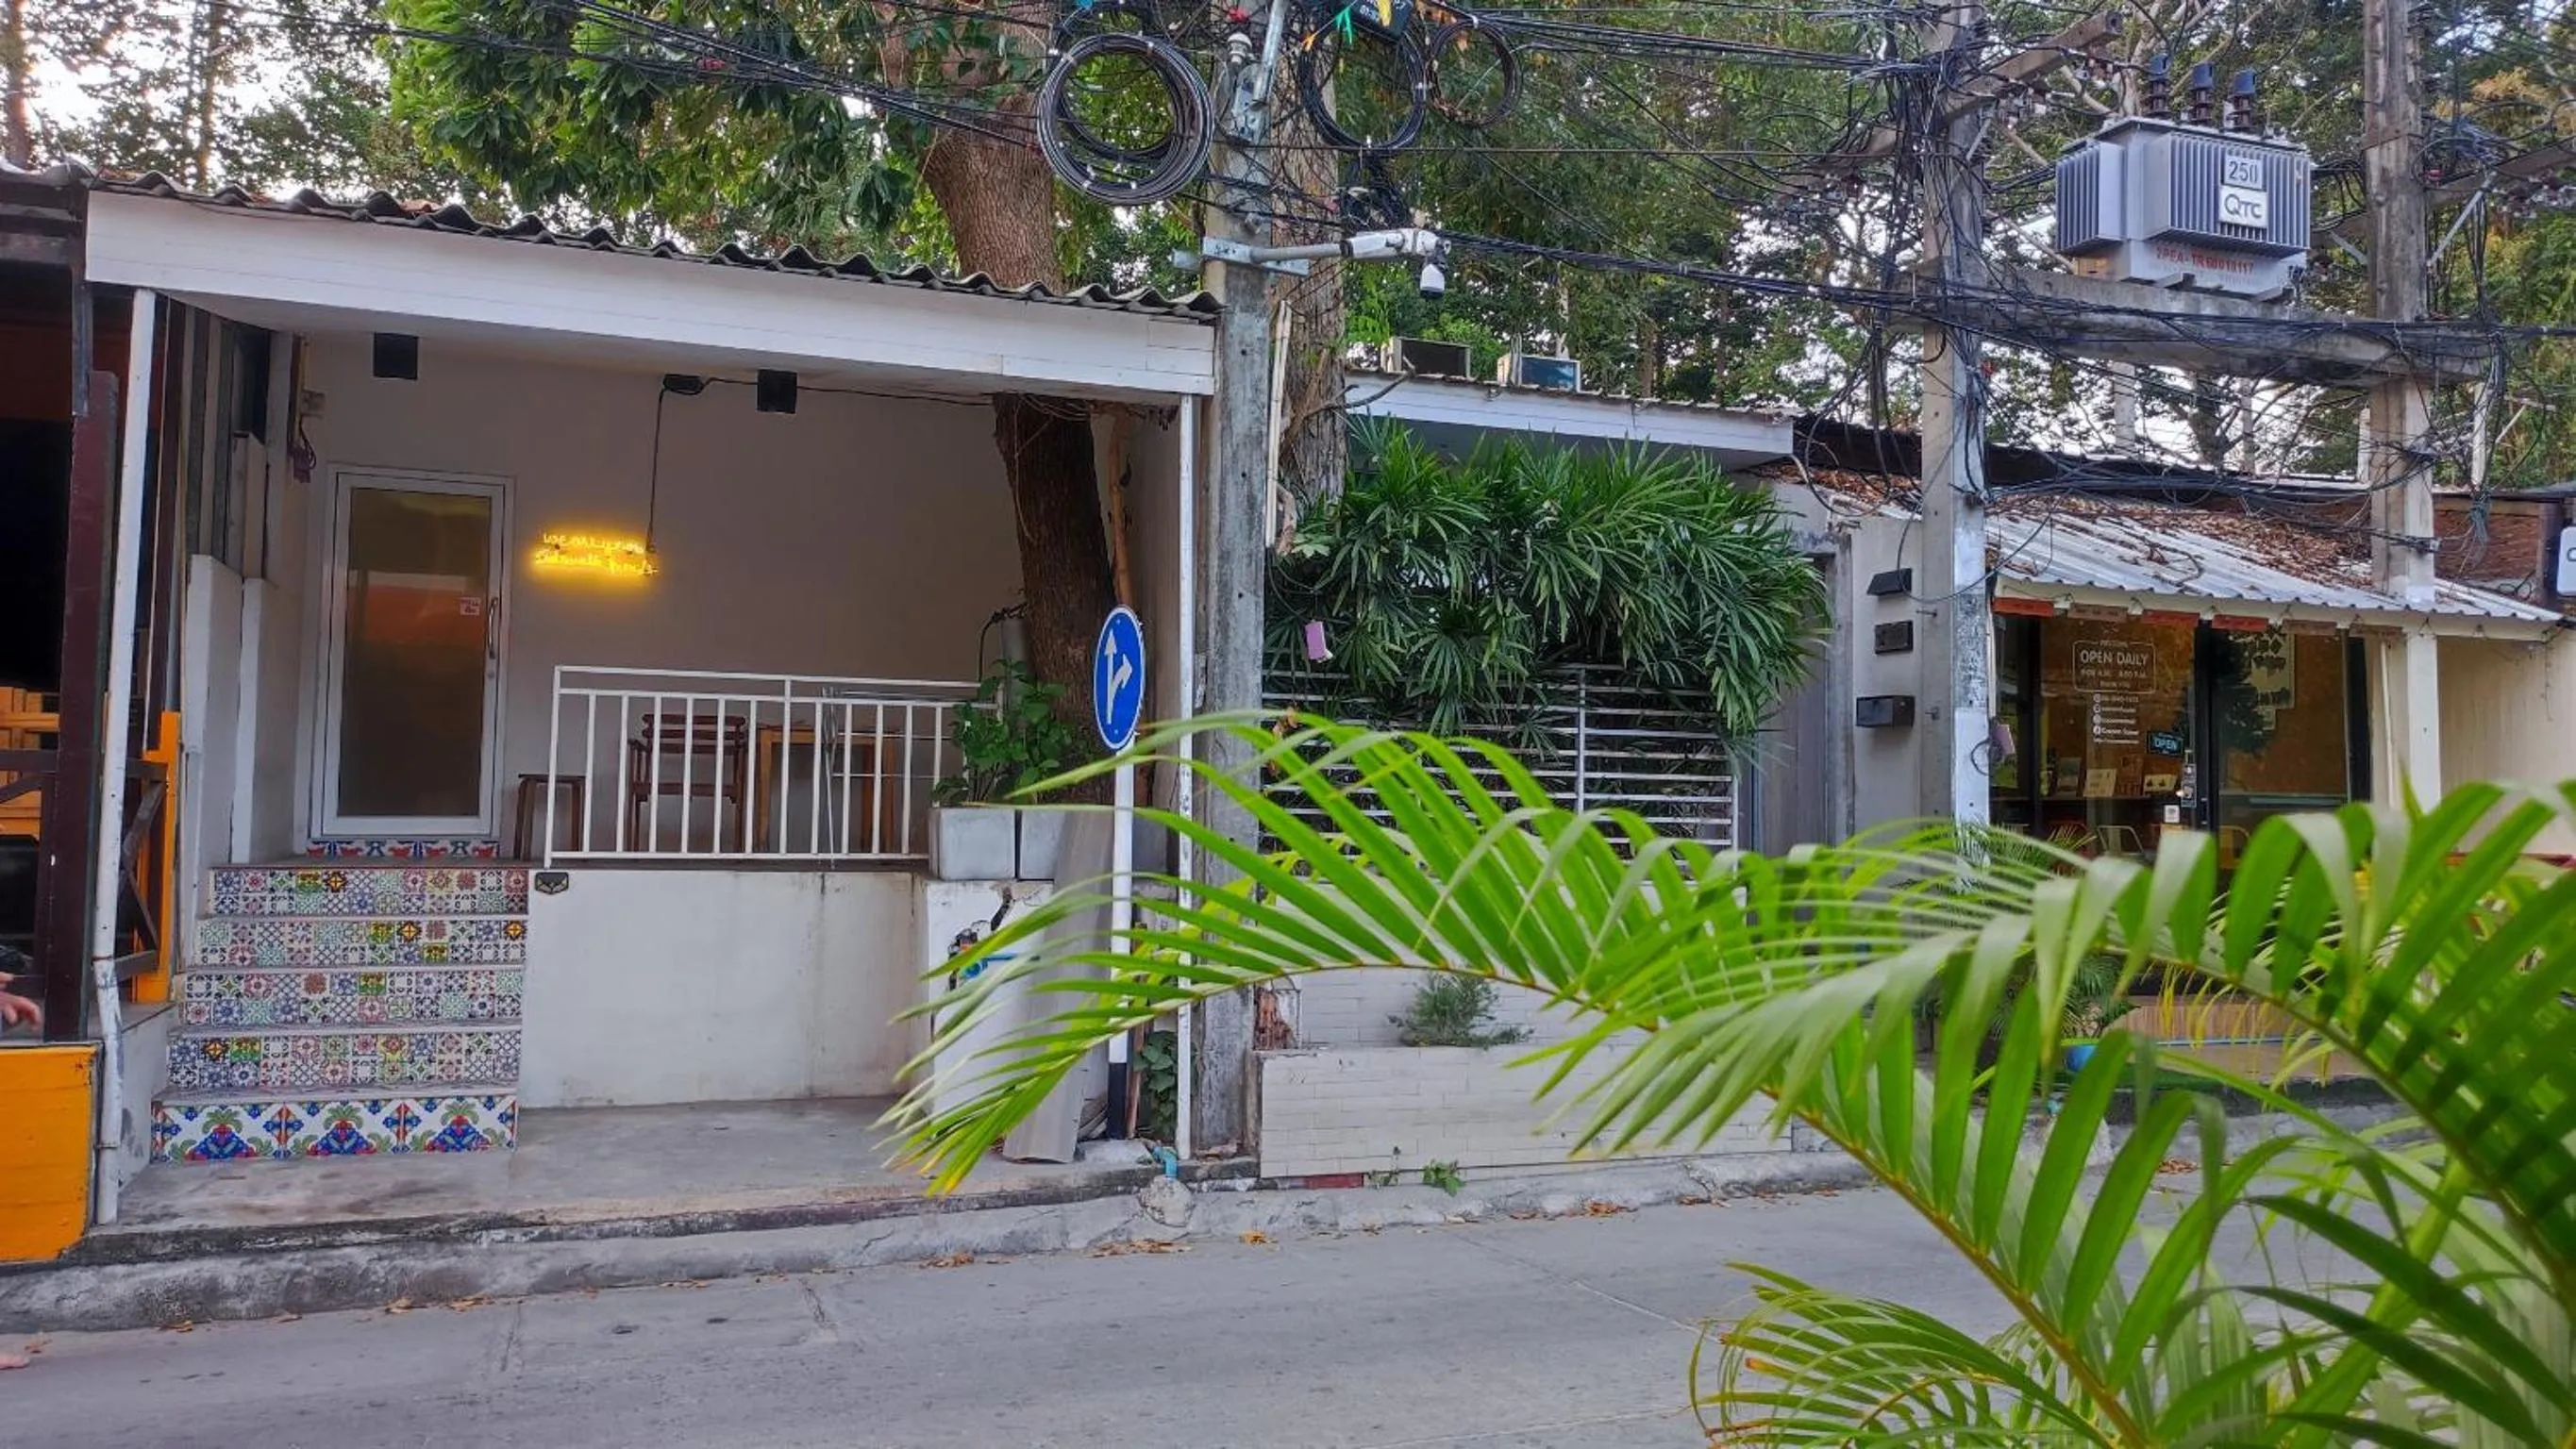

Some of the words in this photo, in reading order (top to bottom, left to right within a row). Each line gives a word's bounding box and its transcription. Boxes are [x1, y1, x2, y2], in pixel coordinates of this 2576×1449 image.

[2229, 160, 2258, 184] 250
[2224, 193, 2263, 219] QTC
[2080, 649, 2114, 664] OPEN
[2116, 651, 2149, 665] DAILY
[2153, 737, 2178, 751] OPEN
